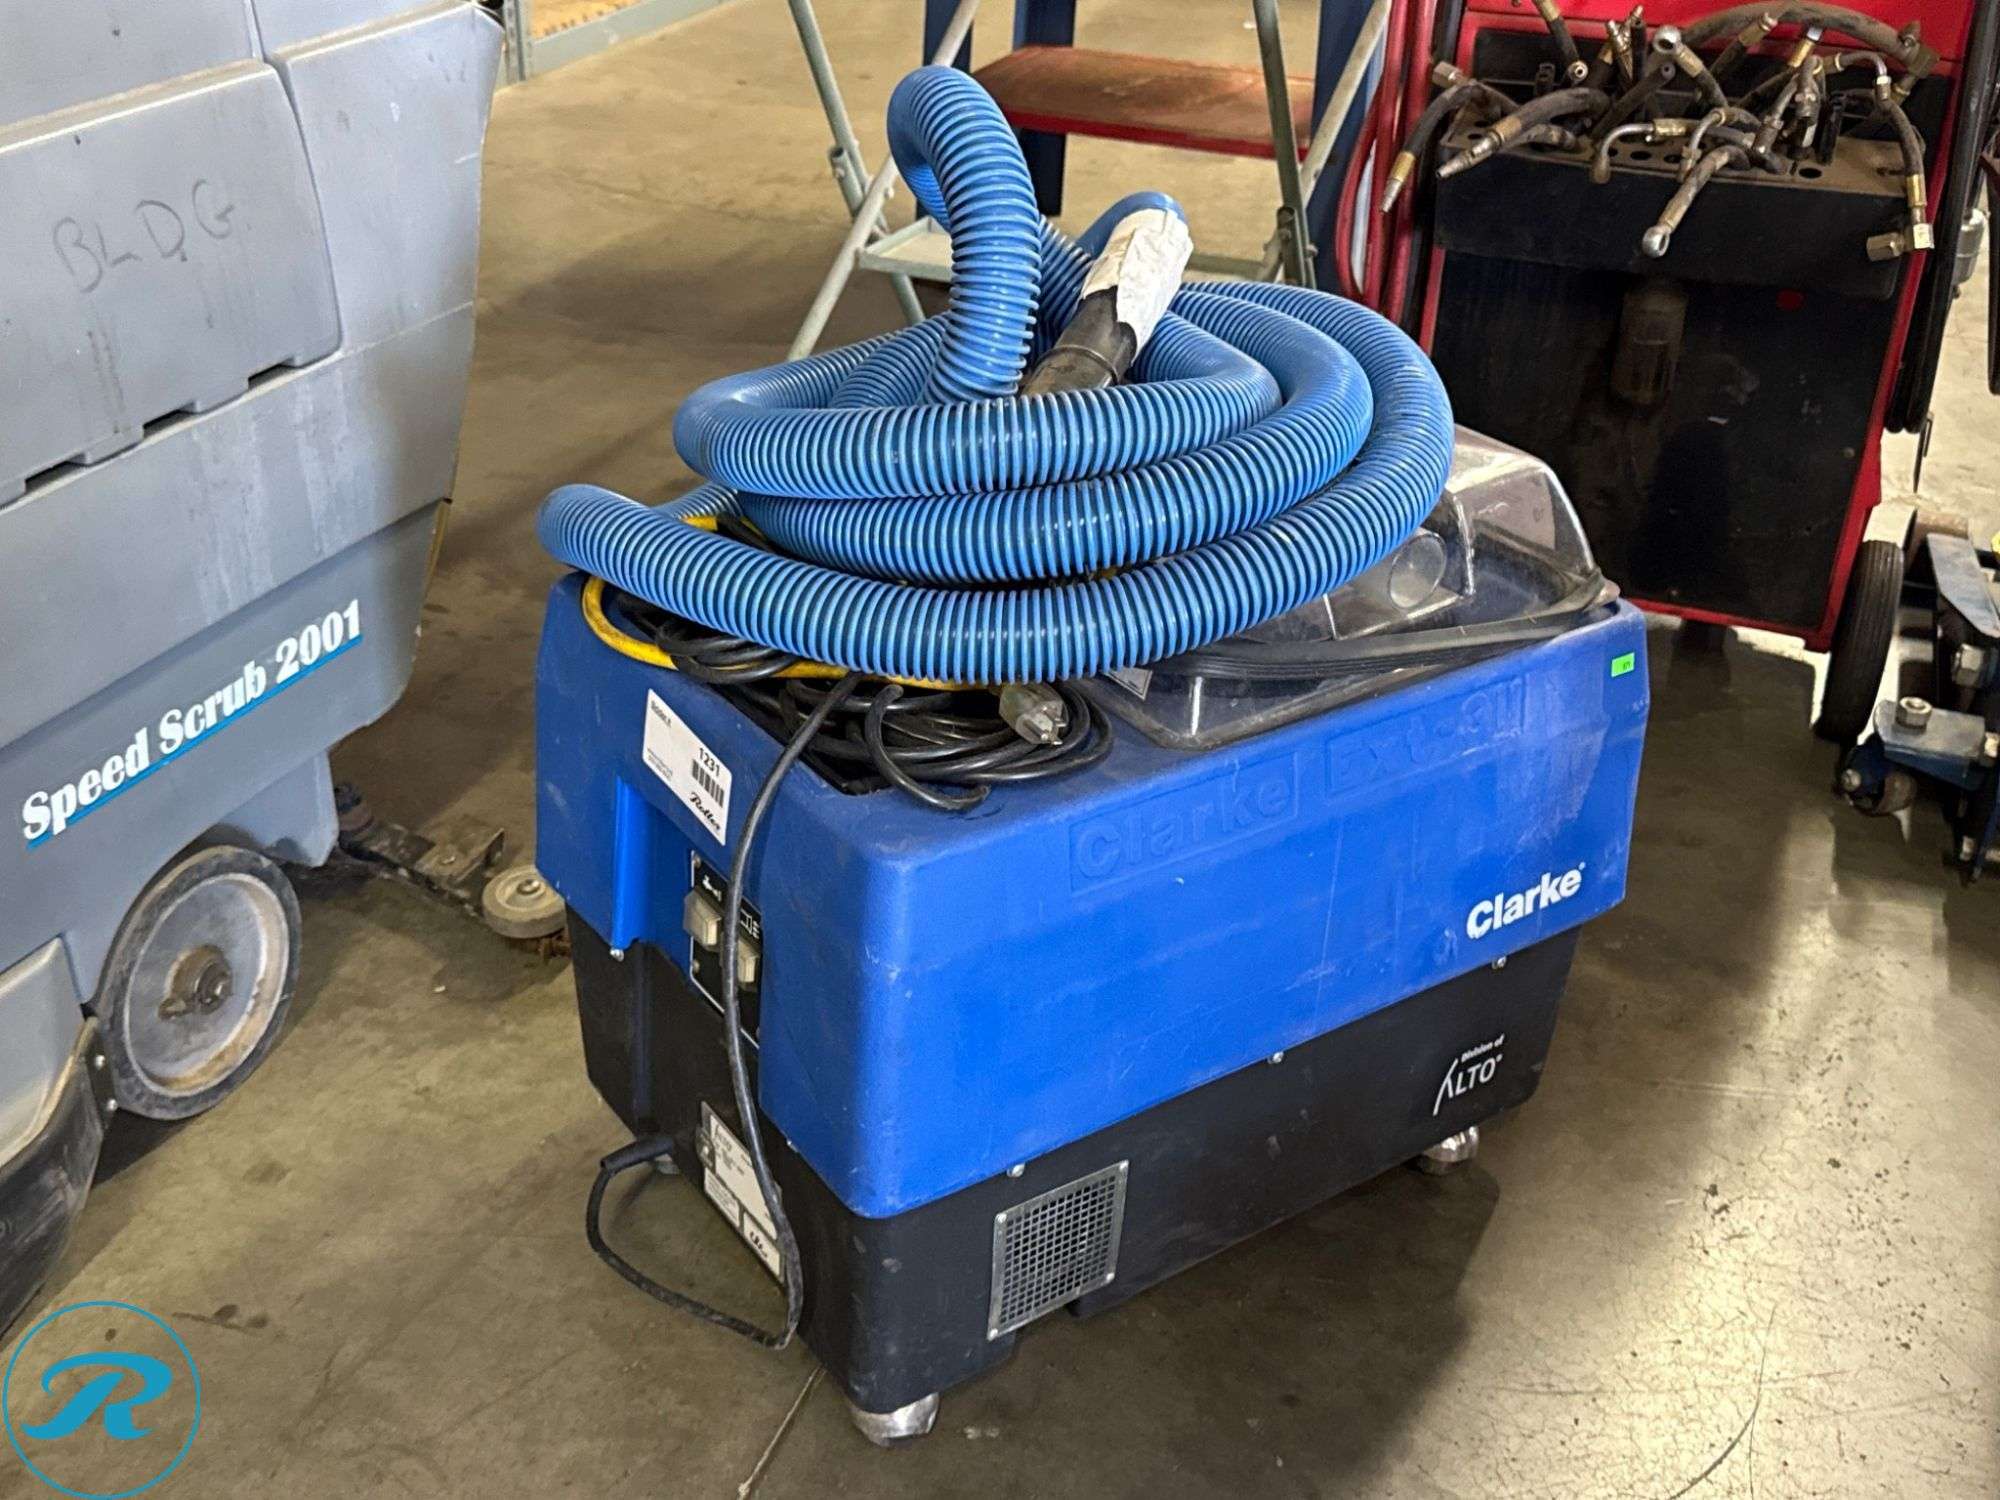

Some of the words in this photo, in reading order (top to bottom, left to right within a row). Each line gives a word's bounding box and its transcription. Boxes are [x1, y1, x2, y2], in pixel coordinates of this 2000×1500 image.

[53, 178, 235, 293] BLDG
[22, 727, 150, 842] Speed
[158, 660, 267, 755] Scrub
[275, 598, 361, 684] 2001
[699, 747, 721, 778] 1231
[1077, 775, 1290, 880] Clarke
[1466, 872, 1583, 940] Clarke
[1432, 1057, 1497, 1117] ALTO
